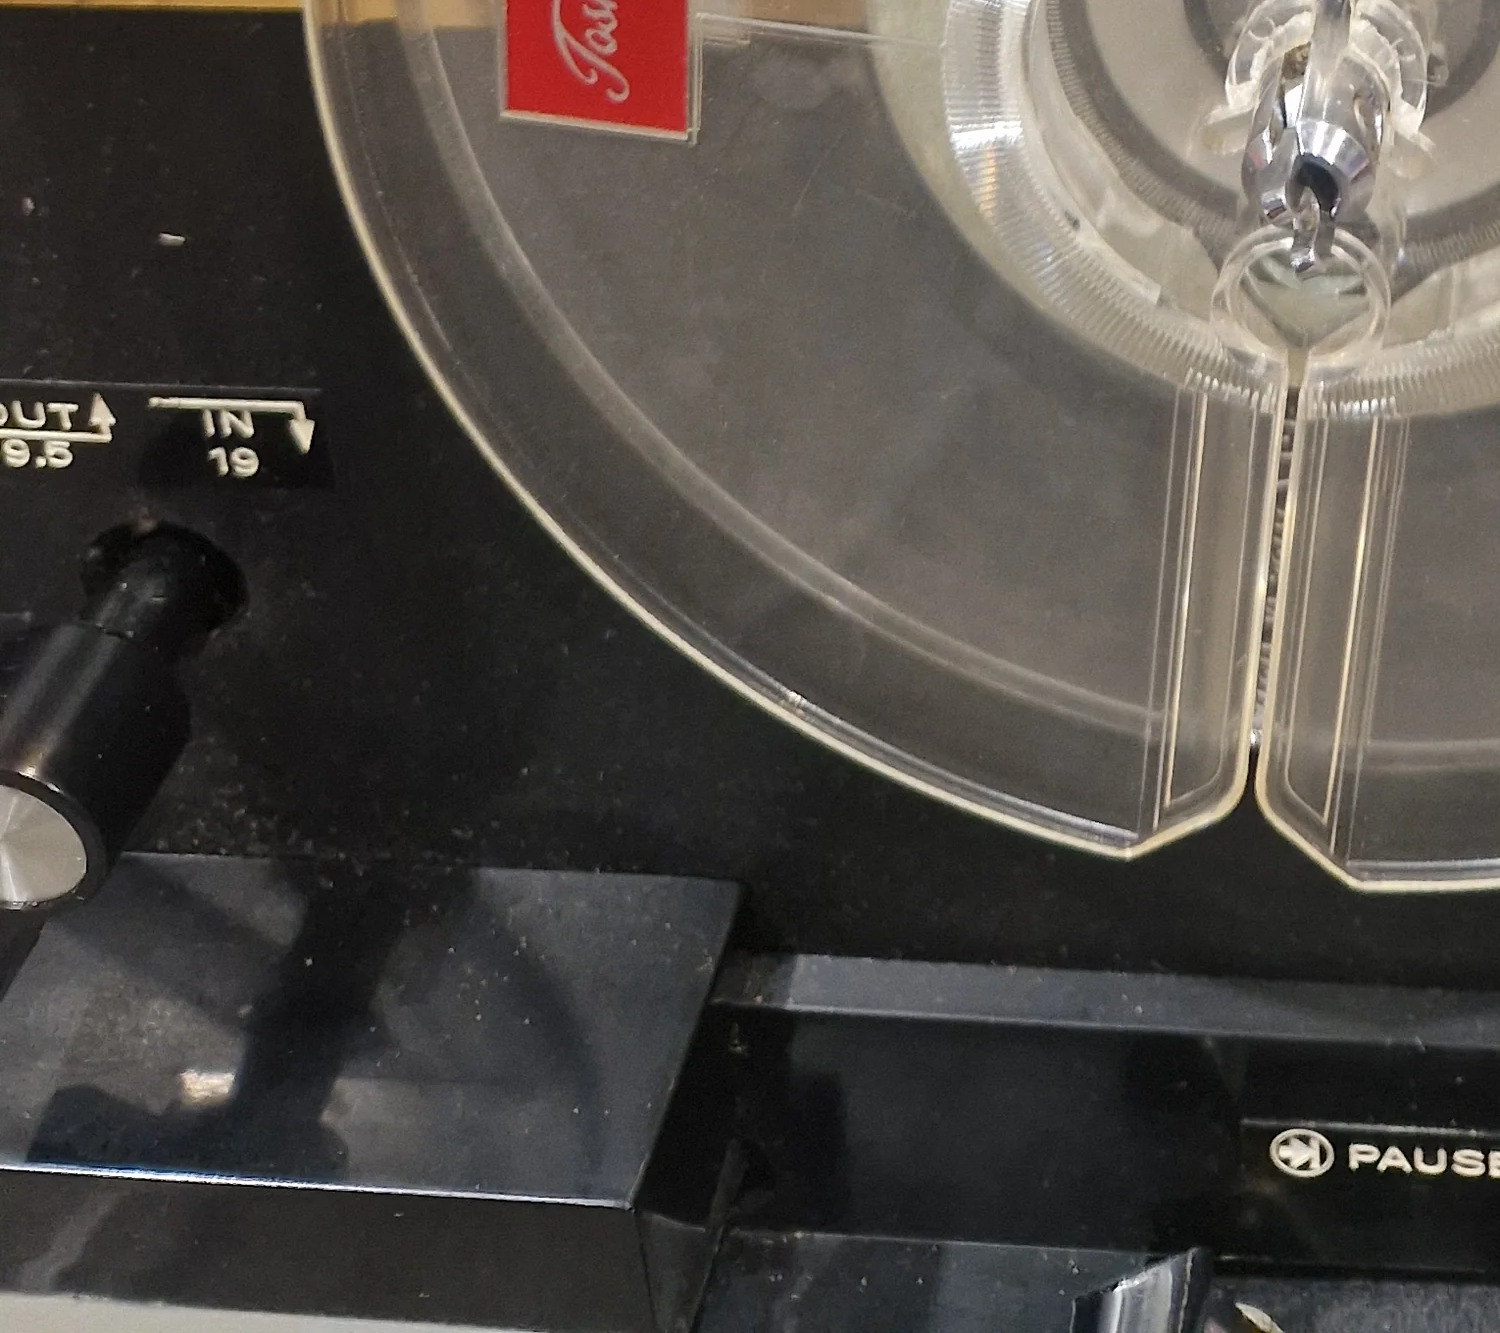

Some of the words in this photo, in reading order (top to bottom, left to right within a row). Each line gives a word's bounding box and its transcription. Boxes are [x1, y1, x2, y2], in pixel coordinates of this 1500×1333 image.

[0, 400, 79, 431] UT
[202, 407, 255, 439] IN
[2, 437, 74, 469] 9.5
[208, 445, 260, 478] 19
